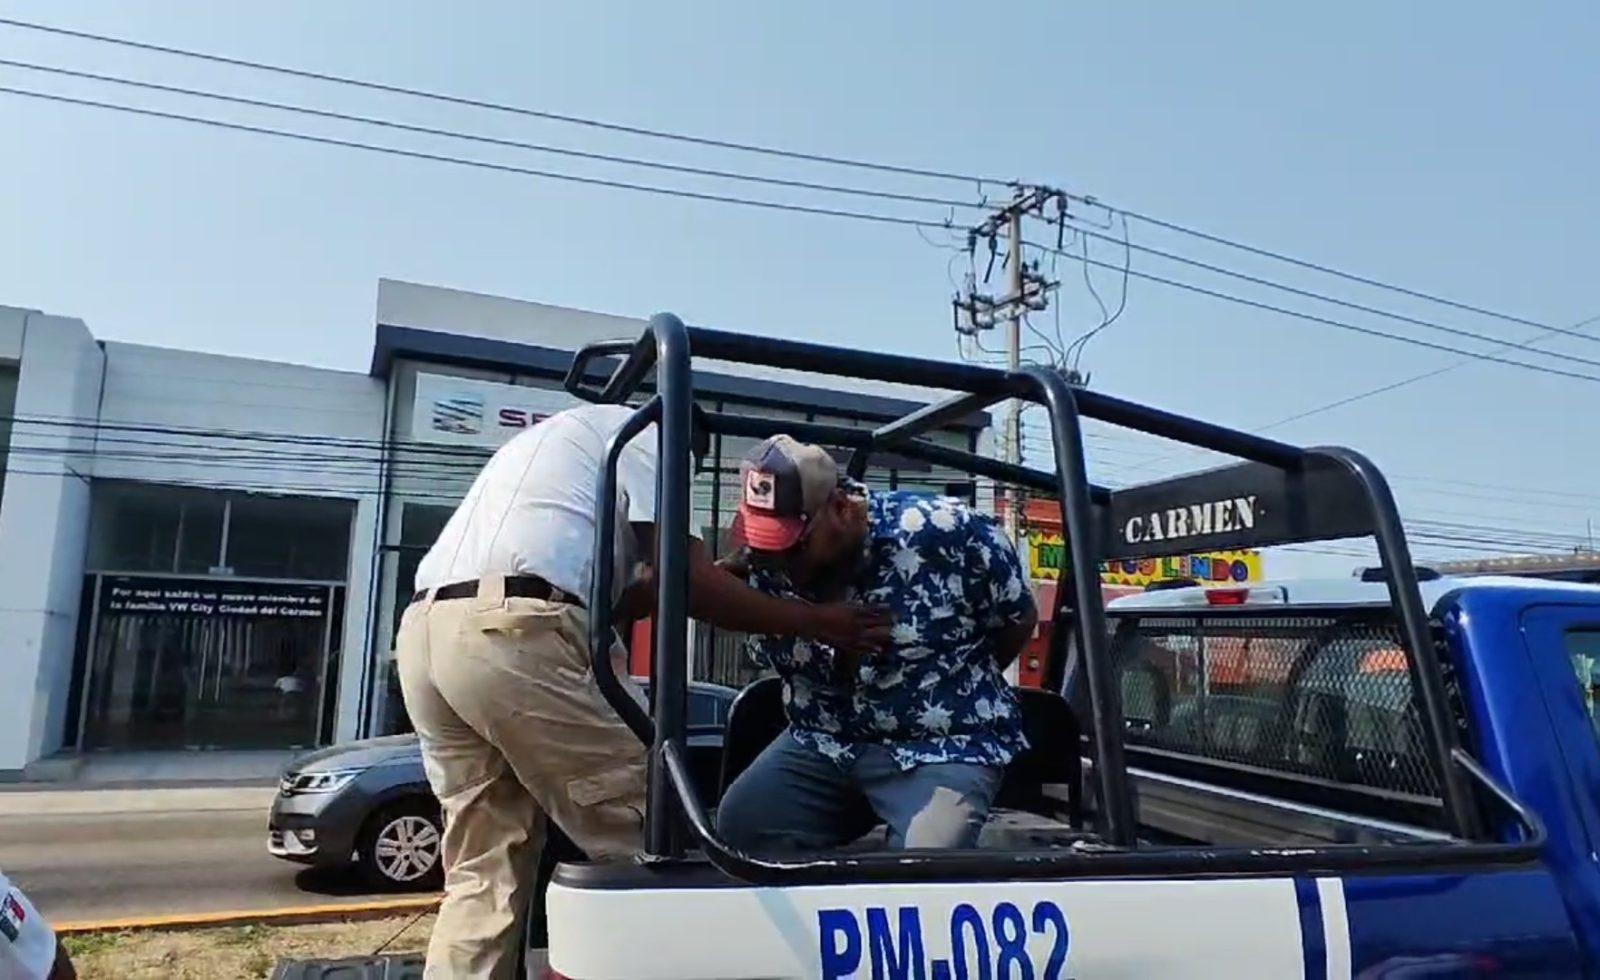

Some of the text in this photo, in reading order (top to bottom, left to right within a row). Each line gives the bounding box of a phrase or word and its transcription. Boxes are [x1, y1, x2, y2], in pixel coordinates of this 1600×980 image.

[1125, 496, 1257, 544] CARMEN
[1162, 555, 1248, 582] LINDO
[169, 602, 188, 611] VW
[191, 603, 213, 614] City
[219, 604, 258, 614] Ciudad
[818, 901, 1069, 980] PM-082
